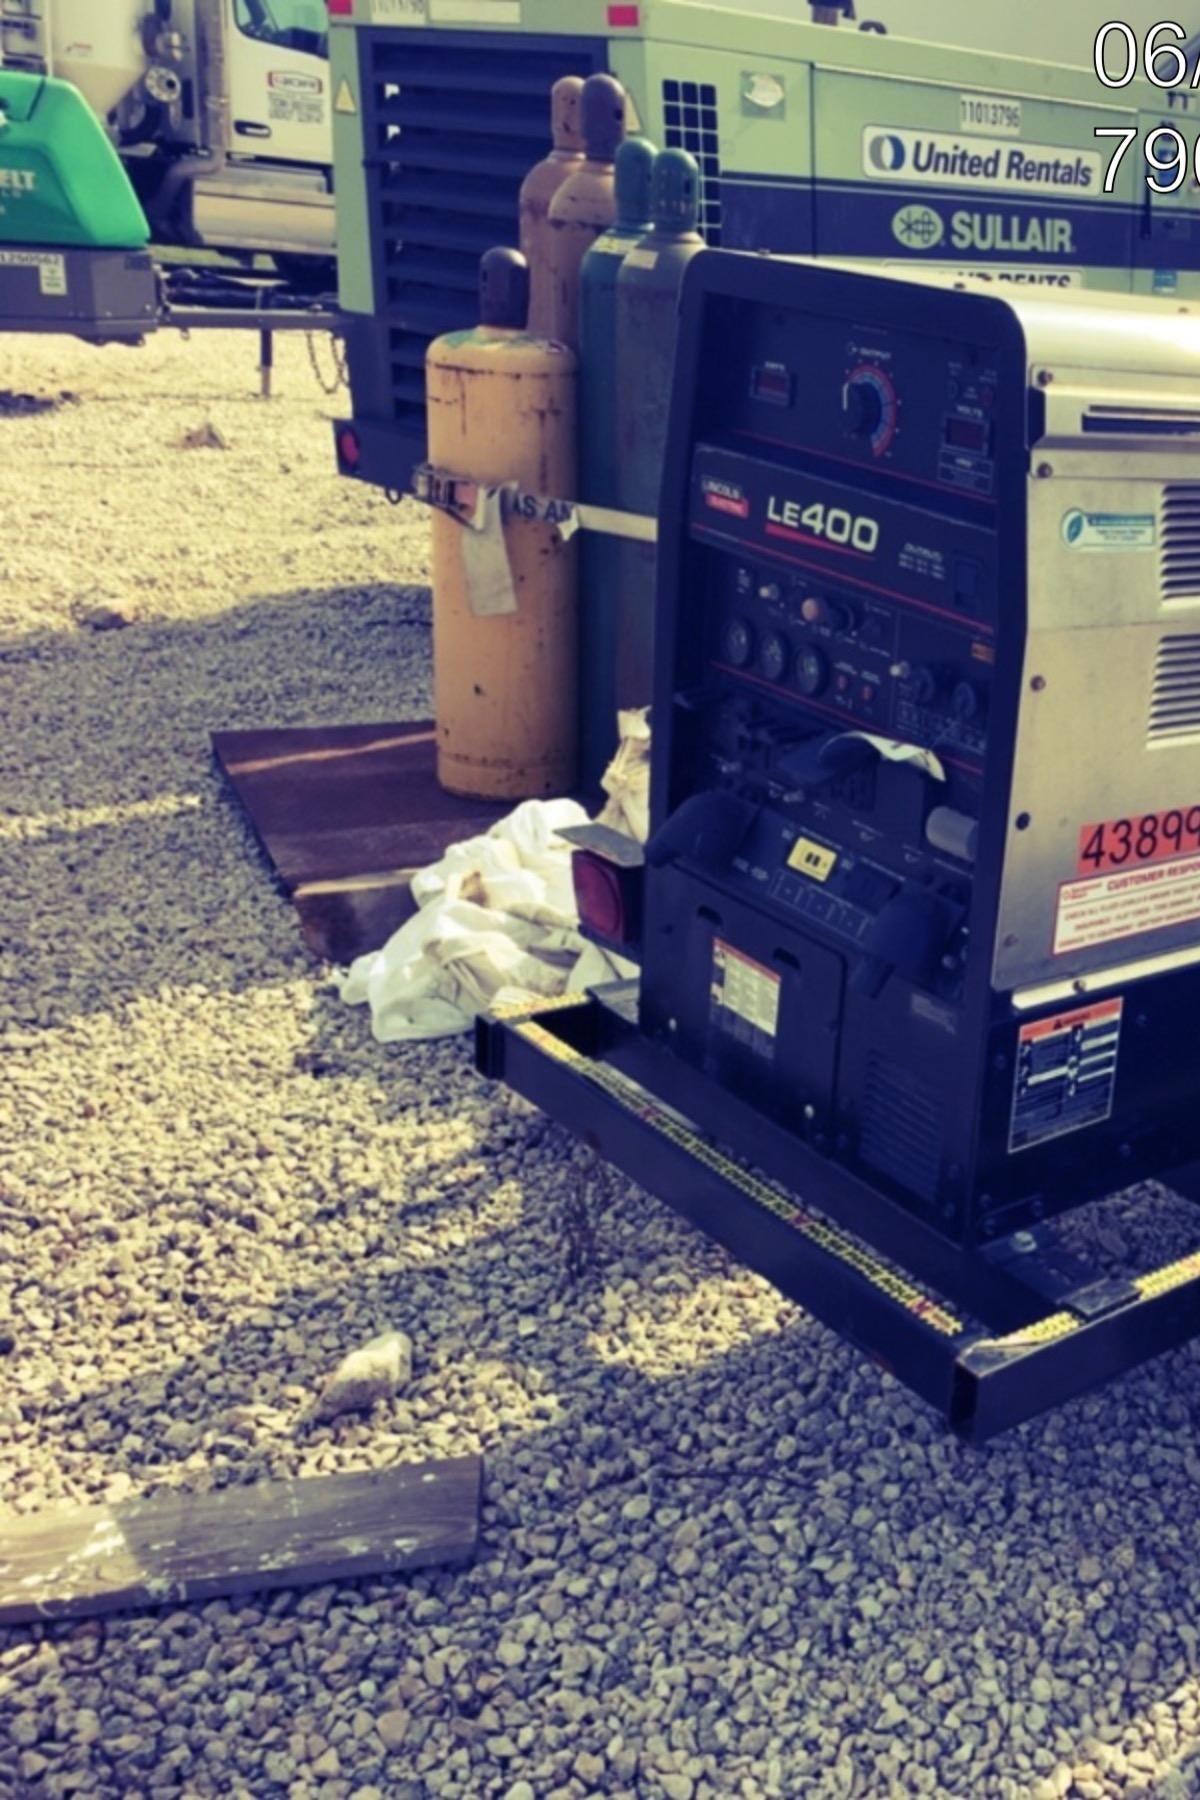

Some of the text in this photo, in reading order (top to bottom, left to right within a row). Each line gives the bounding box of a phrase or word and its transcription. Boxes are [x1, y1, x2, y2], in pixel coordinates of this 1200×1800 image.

[961, 101, 1020, 128] 11013796
[913, 140, 1092, 188] United Rentals
[952, 210, 1075, 253] SULLAIR
[766, 495, 879, 552] LE400
[1107, 868, 1165, 891] CUSTOMER
